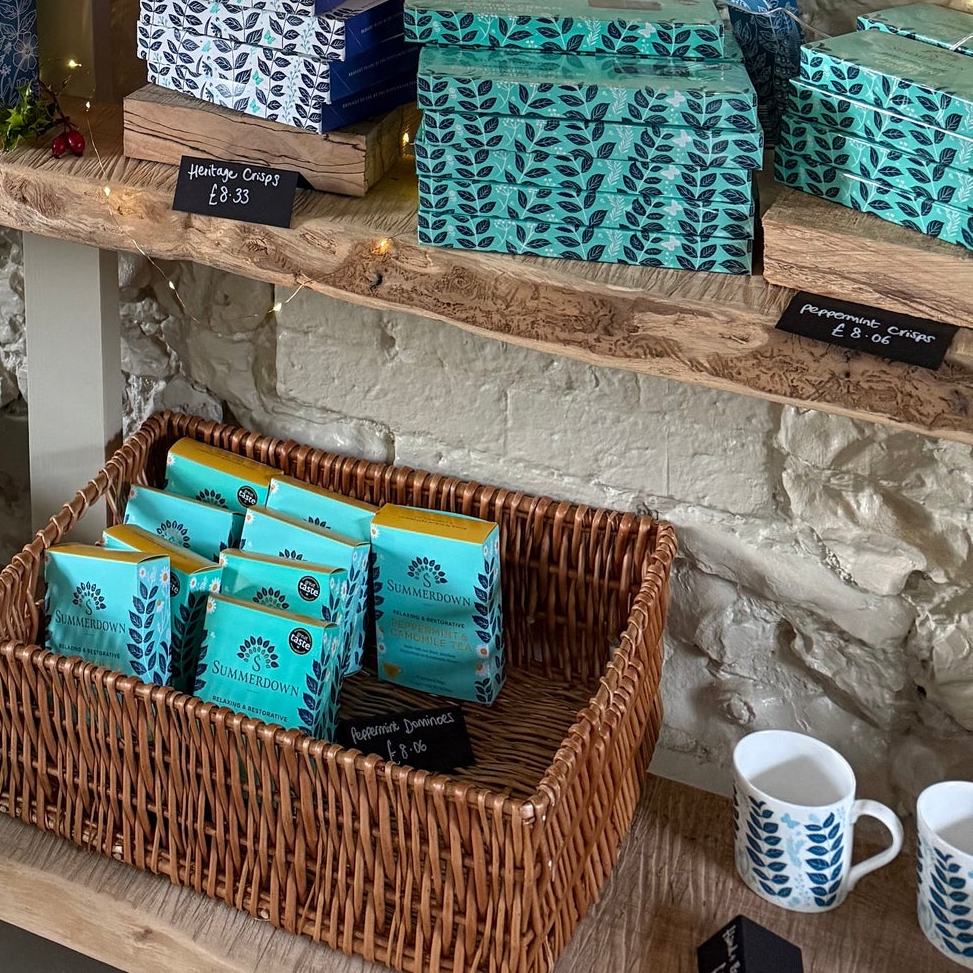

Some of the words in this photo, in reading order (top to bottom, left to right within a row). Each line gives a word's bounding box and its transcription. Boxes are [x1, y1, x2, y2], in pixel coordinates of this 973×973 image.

[188, 163, 238, 182] Heritage
[242, 168, 280, 187] Crisps
[208, 185, 249, 206] £8.33
[237, 490, 257, 505] taste
[298, 584, 319, 597] taste
[387, 579, 471, 607] SUMMERDOWN
[55, 609, 126, 634] SUMMERDOWN
[390, 617, 458, 640] PEPPERMINT
[459, 633, 467, 642] &
[290, 636, 311, 651] taste
[390, 627, 447, 648] CAMOMILE
[450, 640, 472, 652] TEA
[211, 660, 300, 697] SUMMERDOWN
[212, 695, 241, 709] RELAXING
[246, 706, 288, 722] RESTORATIVE
[350, 722, 400, 745] Peppermint
[403, 712, 455, 734] Dominoes
